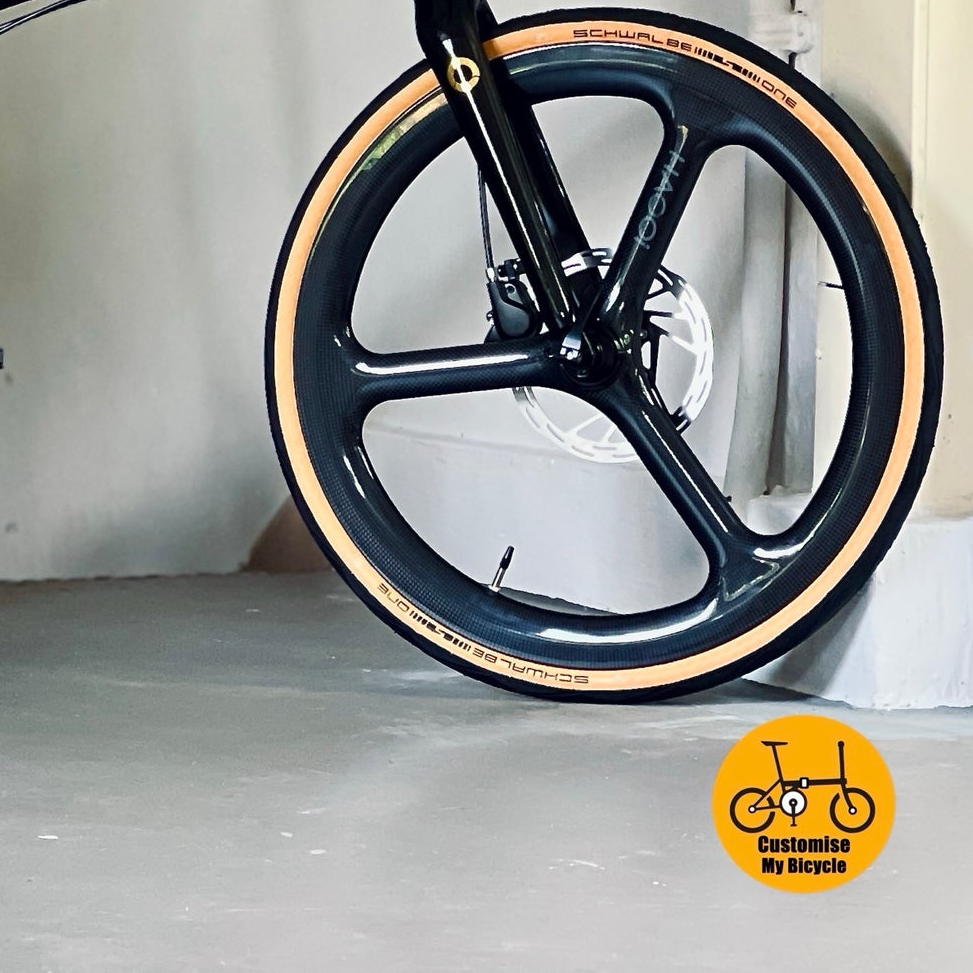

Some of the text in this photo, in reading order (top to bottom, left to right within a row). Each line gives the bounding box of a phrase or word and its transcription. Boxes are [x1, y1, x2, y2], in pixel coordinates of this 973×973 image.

[572, 29, 798, 109] SCHWALBE ONE
[377, 583, 589, 684] SCHWALBE ONE
